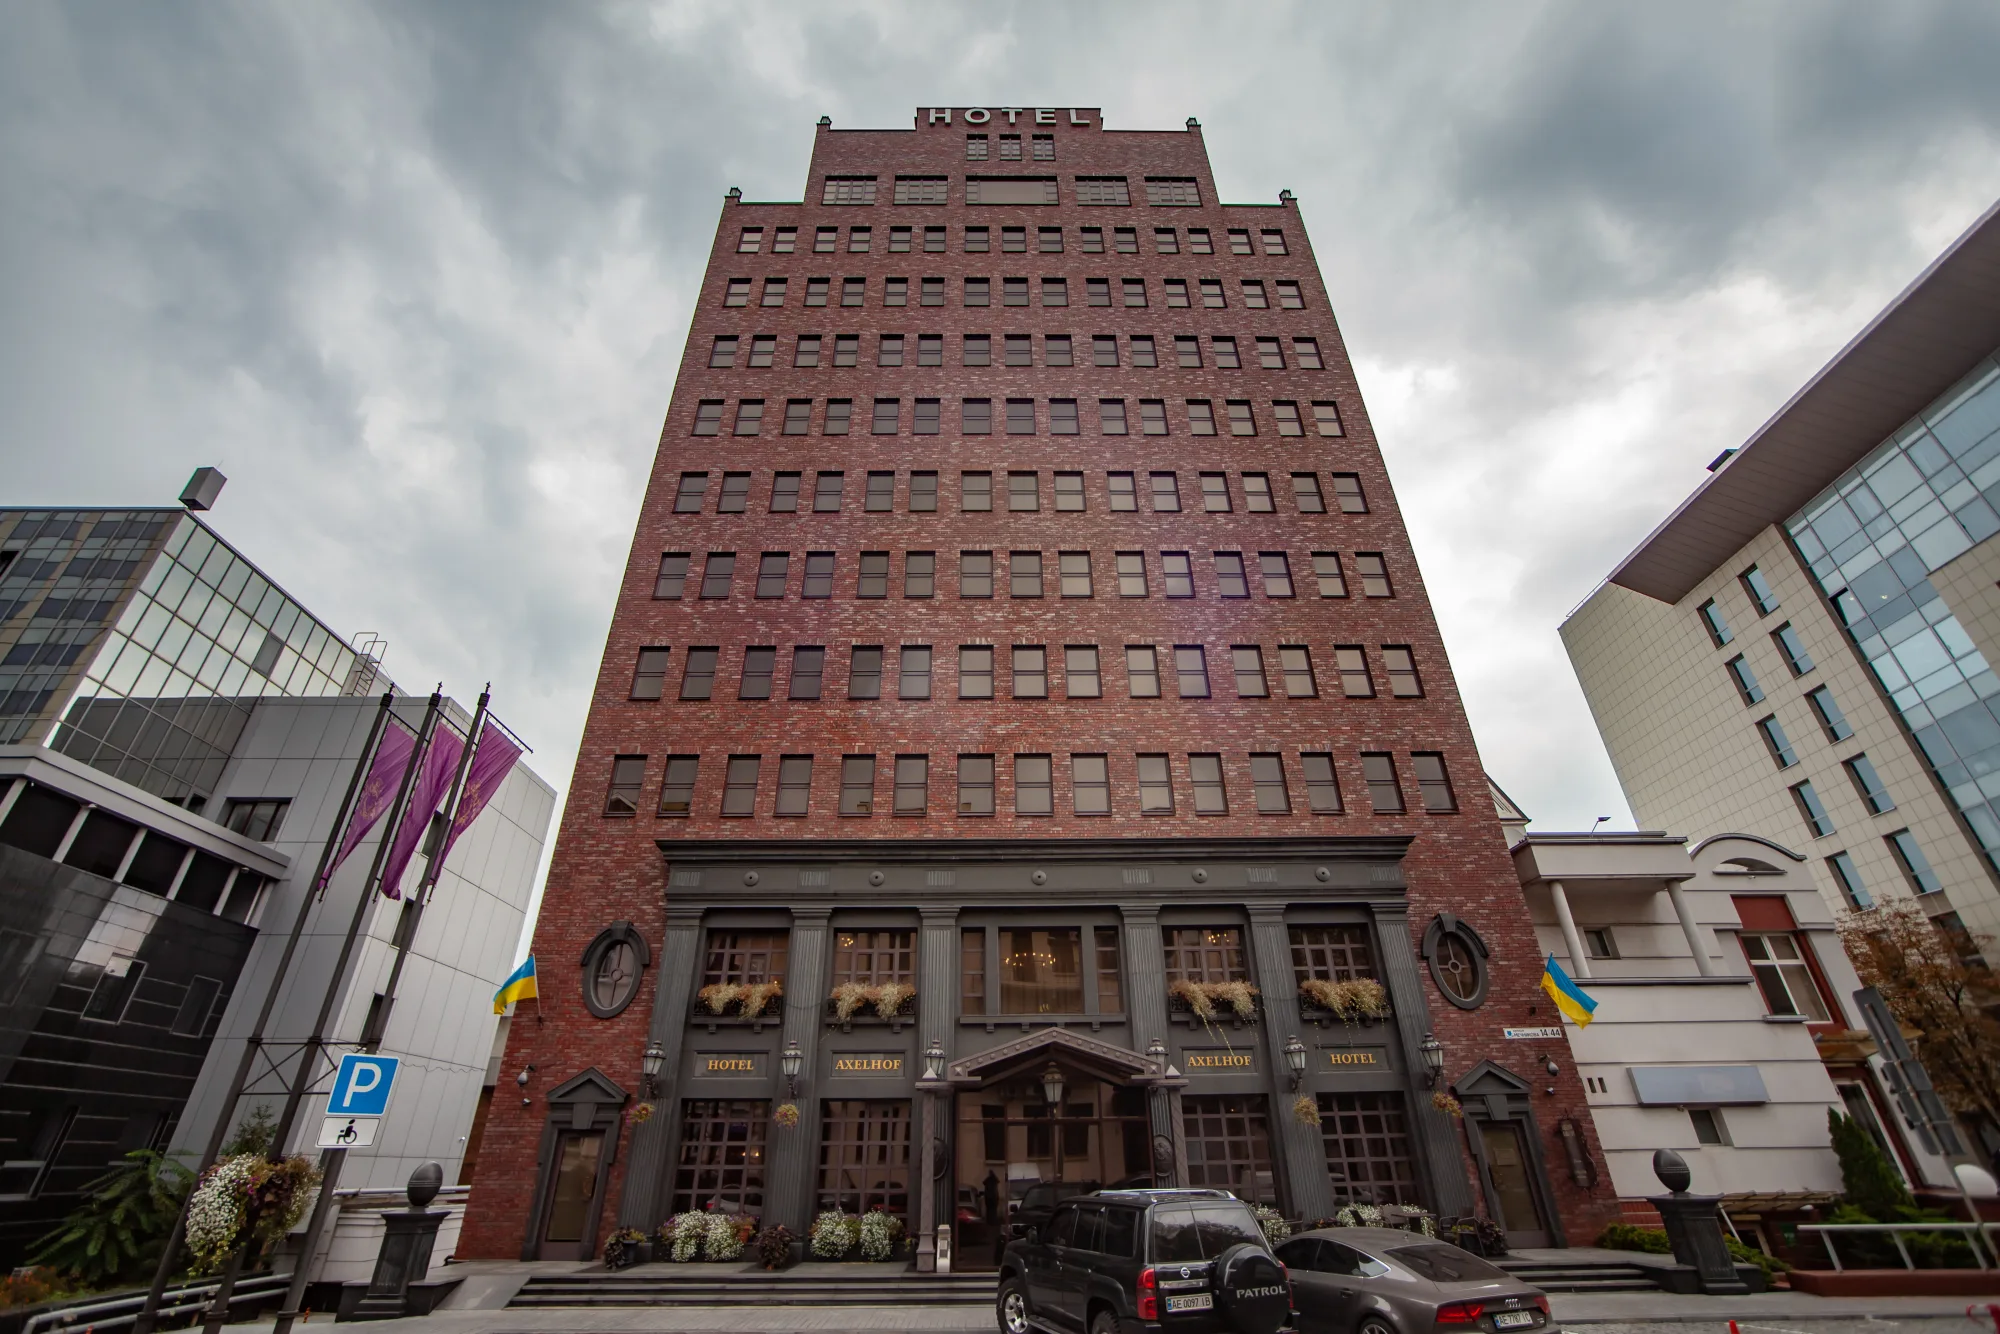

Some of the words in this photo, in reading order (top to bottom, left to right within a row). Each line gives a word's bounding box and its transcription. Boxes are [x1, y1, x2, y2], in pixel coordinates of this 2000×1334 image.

[929, 108, 1091, 125] HOTEL
[1187, 1055, 1251, 1067] AXELHOF
[1330, 1053, 1377, 1064] HOTEL
[707, 1059, 754, 1071] HOTEL
[835, 1059, 901, 1071] AXELHOF
[342, 1061, 382, 1107] P
[1236, 1286, 1286, 1298] PATROL
[1172, 1299, 1182, 1309] AE
[1183, 1298, 1199, 1308] 0097
